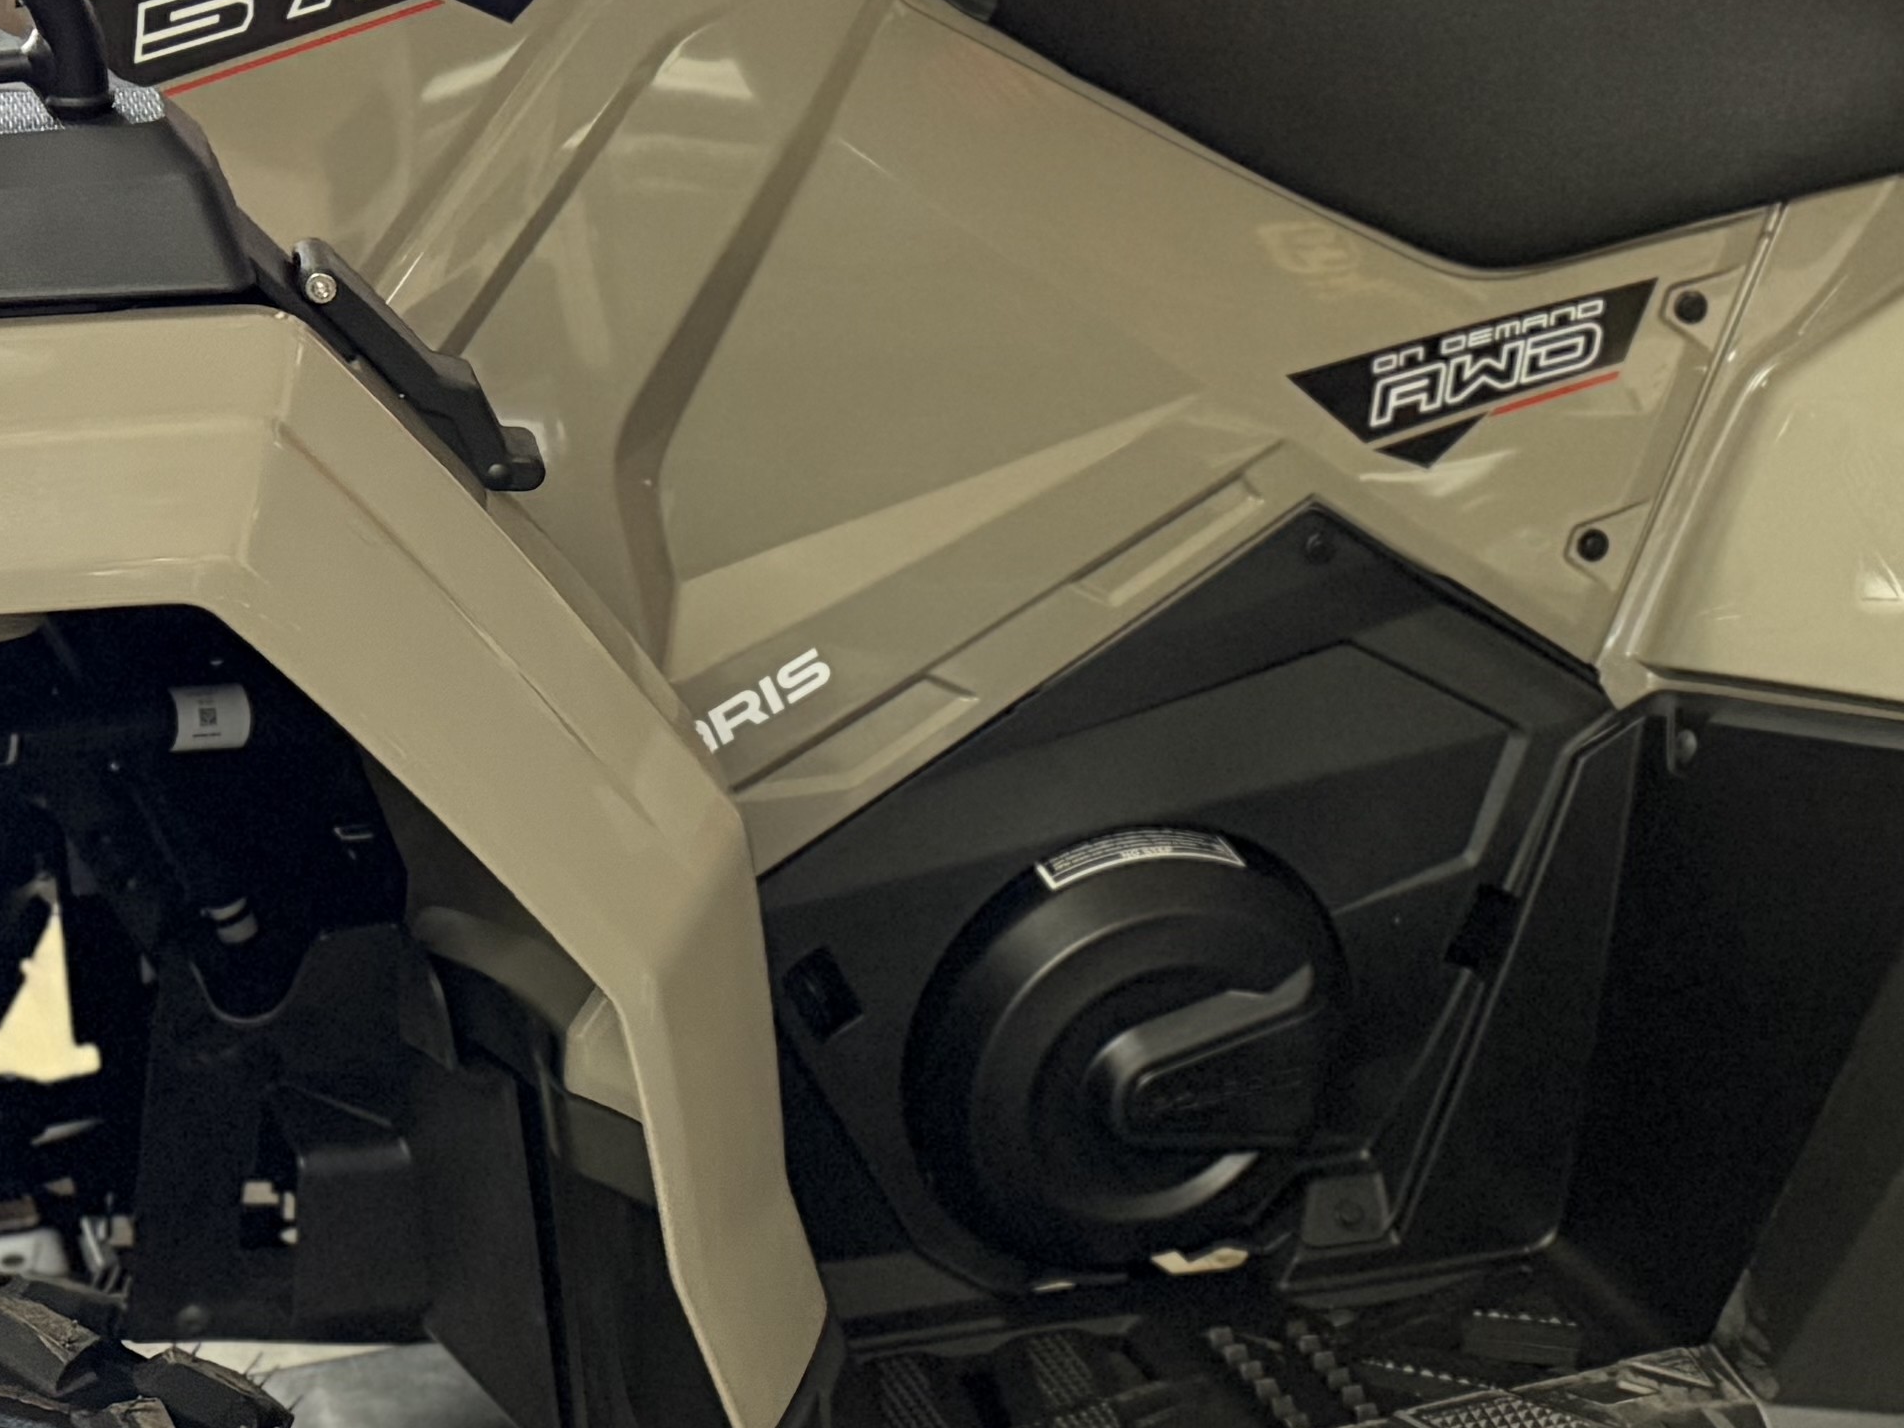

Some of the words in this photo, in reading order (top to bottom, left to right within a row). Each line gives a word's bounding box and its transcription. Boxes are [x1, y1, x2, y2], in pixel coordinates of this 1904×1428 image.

[1369, 322, 1603, 427] AWD
[1372, 346, 1424, 374] ON
[1440, 298, 1604, 356] DEMAND
